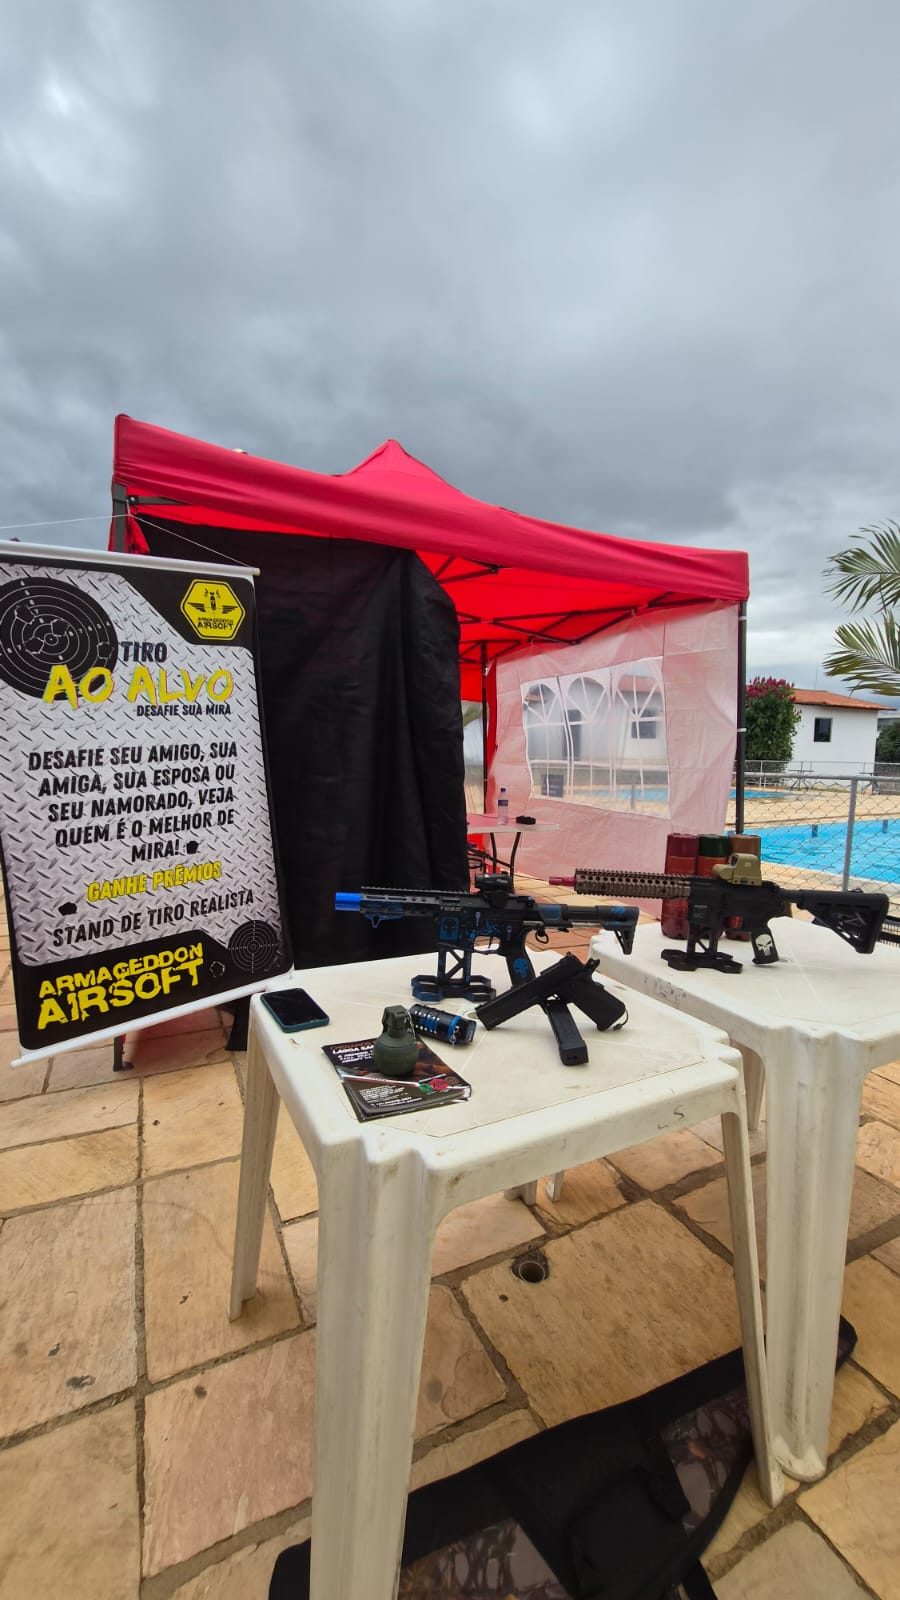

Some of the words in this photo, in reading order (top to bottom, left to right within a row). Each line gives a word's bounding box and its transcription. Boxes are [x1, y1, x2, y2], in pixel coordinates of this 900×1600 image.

[198, 621, 233, 630] AIRSOFT
[121, 641, 168, 663] TIRO
[42, 664, 114, 709] AO
[127, 665, 234, 705] ALVO
[136, 705, 180, 717] DESAFIE
[182, 704, 203, 716] SUA
[205, 704, 232, 716] MIRA
[28, 748, 105, 771] DESAFIE
[110, 746, 143, 765] SEU
[148, 743, 205, 763] AMIGO,
[210, 741, 238, 759] SUA
[38, 774, 107, 797] AMIGA,
[113, 771, 147, 791] SUA
[153, 766, 210, 787] ESPOSA
[215, 764, 235, 781] OU
[48, 801, 84, 823] SEU
[91, 790, 193, 818] NAMORADO,
[198, 786, 235, 806] VEJA
[55, 823, 109, 848] QUEM
[116, 818, 126, 841] É
[131, 820, 143, 838] O
[149, 811, 212, 836] MELHOR
[217, 808, 235, 826] DE
[131, 839, 180, 863] MIRA!
[87, 874, 148, 903] GANHE
[152, 861, 223, 891] PRÊMIOS
[53, 919, 114, 947] STAND
[121, 913, 142, 933] DE
[148, 903, 185, 927] TIRO
[190, 889, 255, 918] REALISTA
[39, 942, 204, 998] ARMAGEDDON
[37, 958, 204, 1030] AIRSOFT
